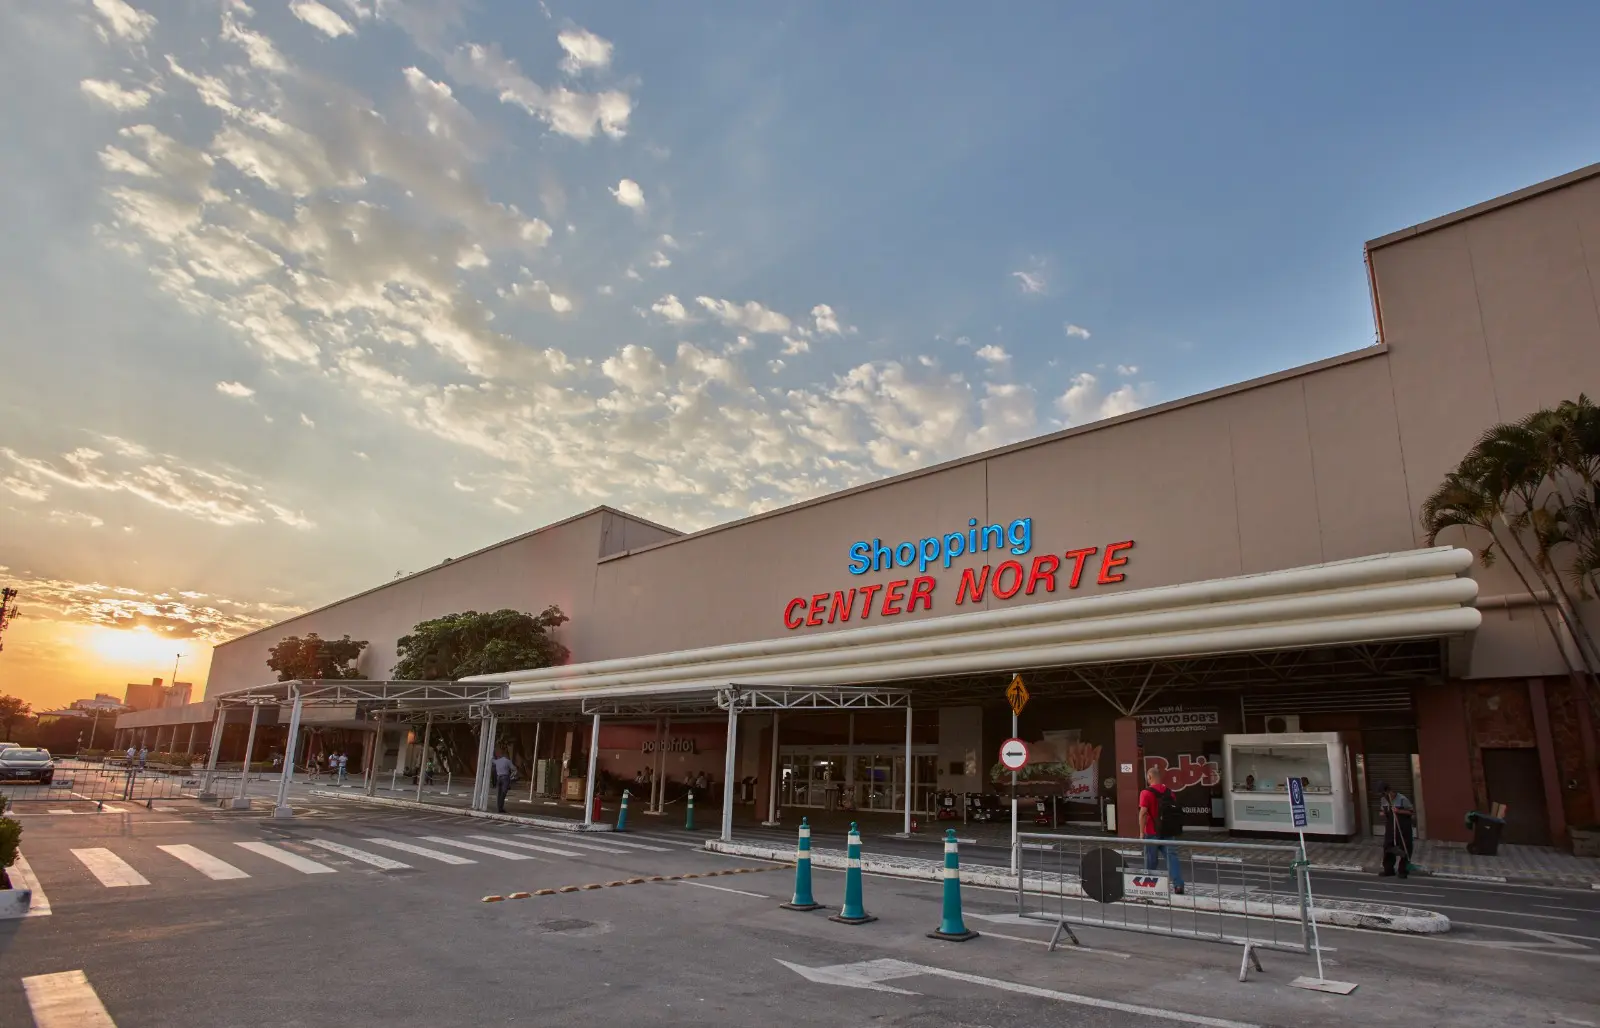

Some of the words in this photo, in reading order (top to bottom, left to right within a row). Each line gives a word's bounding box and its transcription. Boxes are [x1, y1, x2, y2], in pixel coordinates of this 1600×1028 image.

[848, 517, 1033, 575] Shopping
[784, 576, 937, 630] CENTER
[956, 540, 1135, 606] NORTE
[1149, 715, 1181, 725] NOVO
[1183, 713, 1217, 723] BOB'S
[1175, 725, 1207, 733] GOSTOSO
